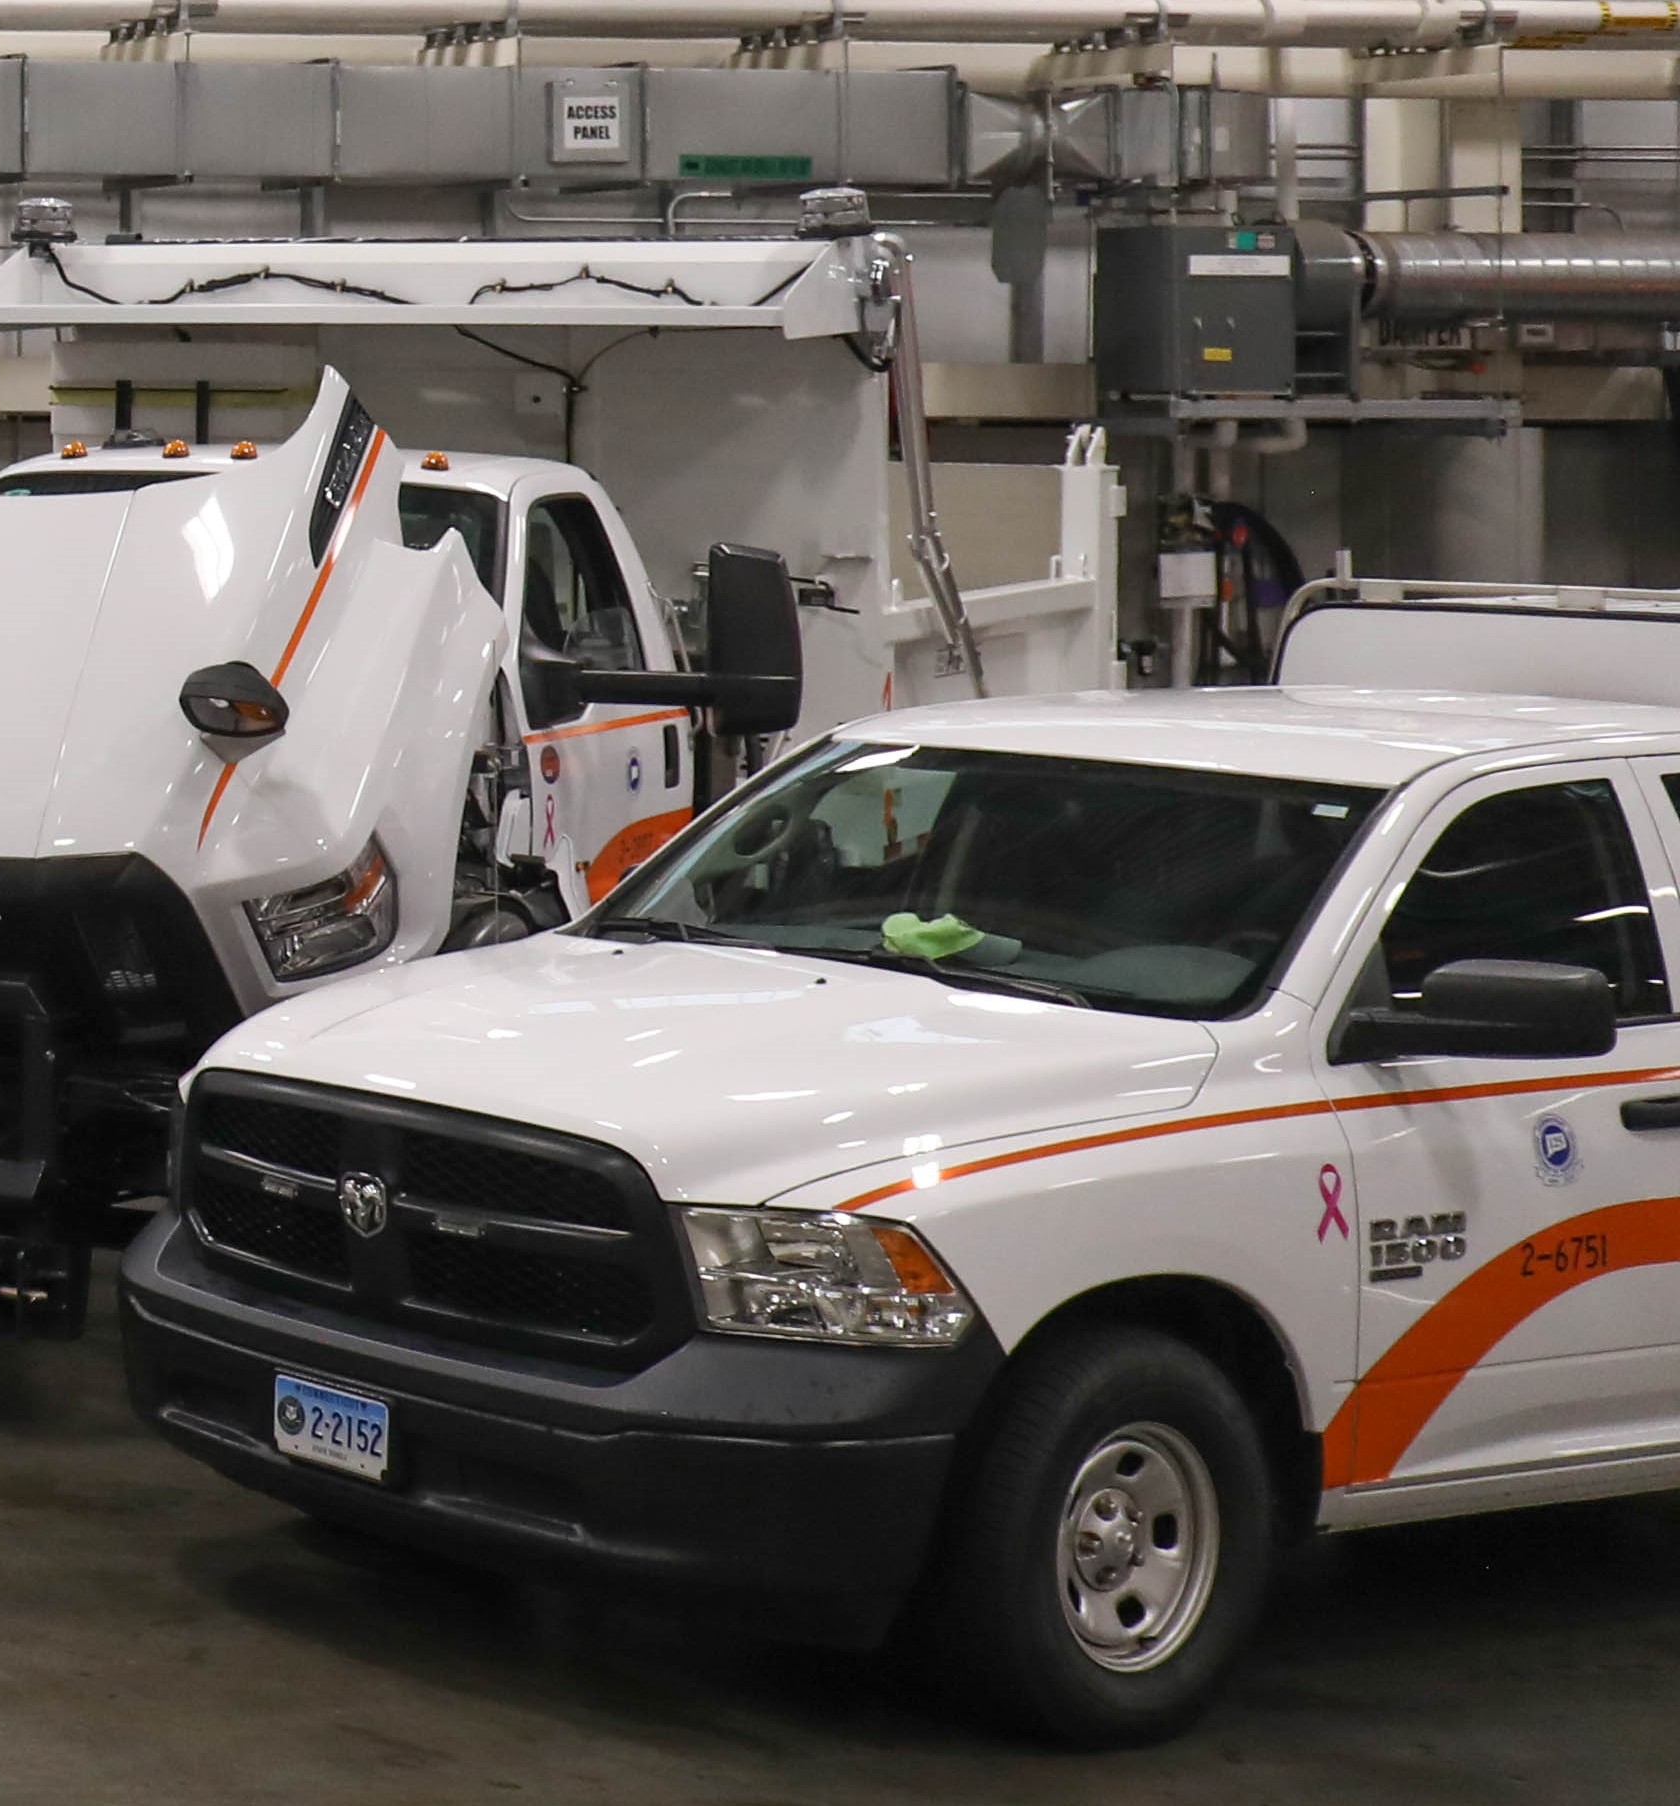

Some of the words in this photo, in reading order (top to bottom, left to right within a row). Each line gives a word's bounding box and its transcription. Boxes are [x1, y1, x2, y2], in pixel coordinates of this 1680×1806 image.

[567, 105, 617, 119] ACCESS
[573, 125, 611, 140] PANEL
[1369, 1210, 1467, 1242] RAM
[1369, 1236, 1467, 1268] 1500
[1520, 1233, 1608, 1278] 2-6751
